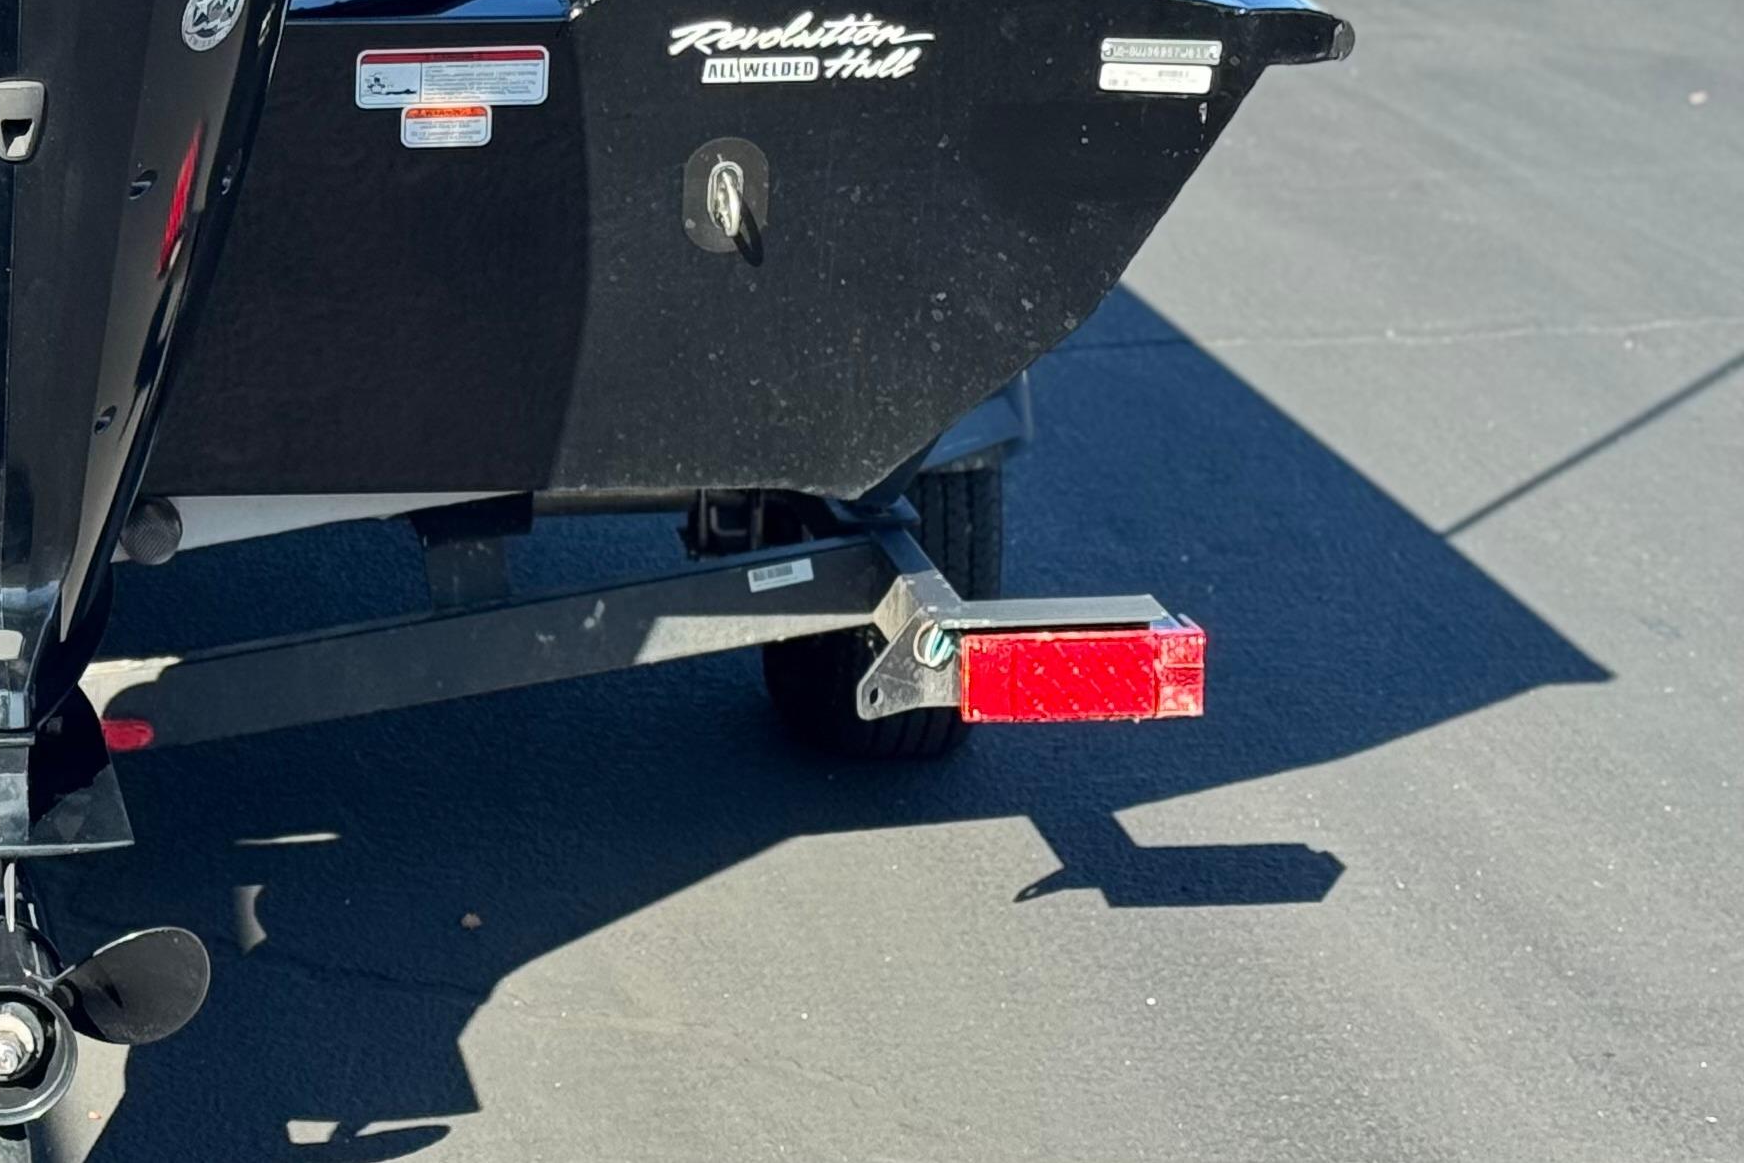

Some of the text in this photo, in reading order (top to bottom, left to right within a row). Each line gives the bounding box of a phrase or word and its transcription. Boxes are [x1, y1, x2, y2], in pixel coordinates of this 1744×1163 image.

[667, 10, 936, 56] Revolution
[707, 60, 815, 79] ALL WELDED
[823, 47, 922, 80] Hull
